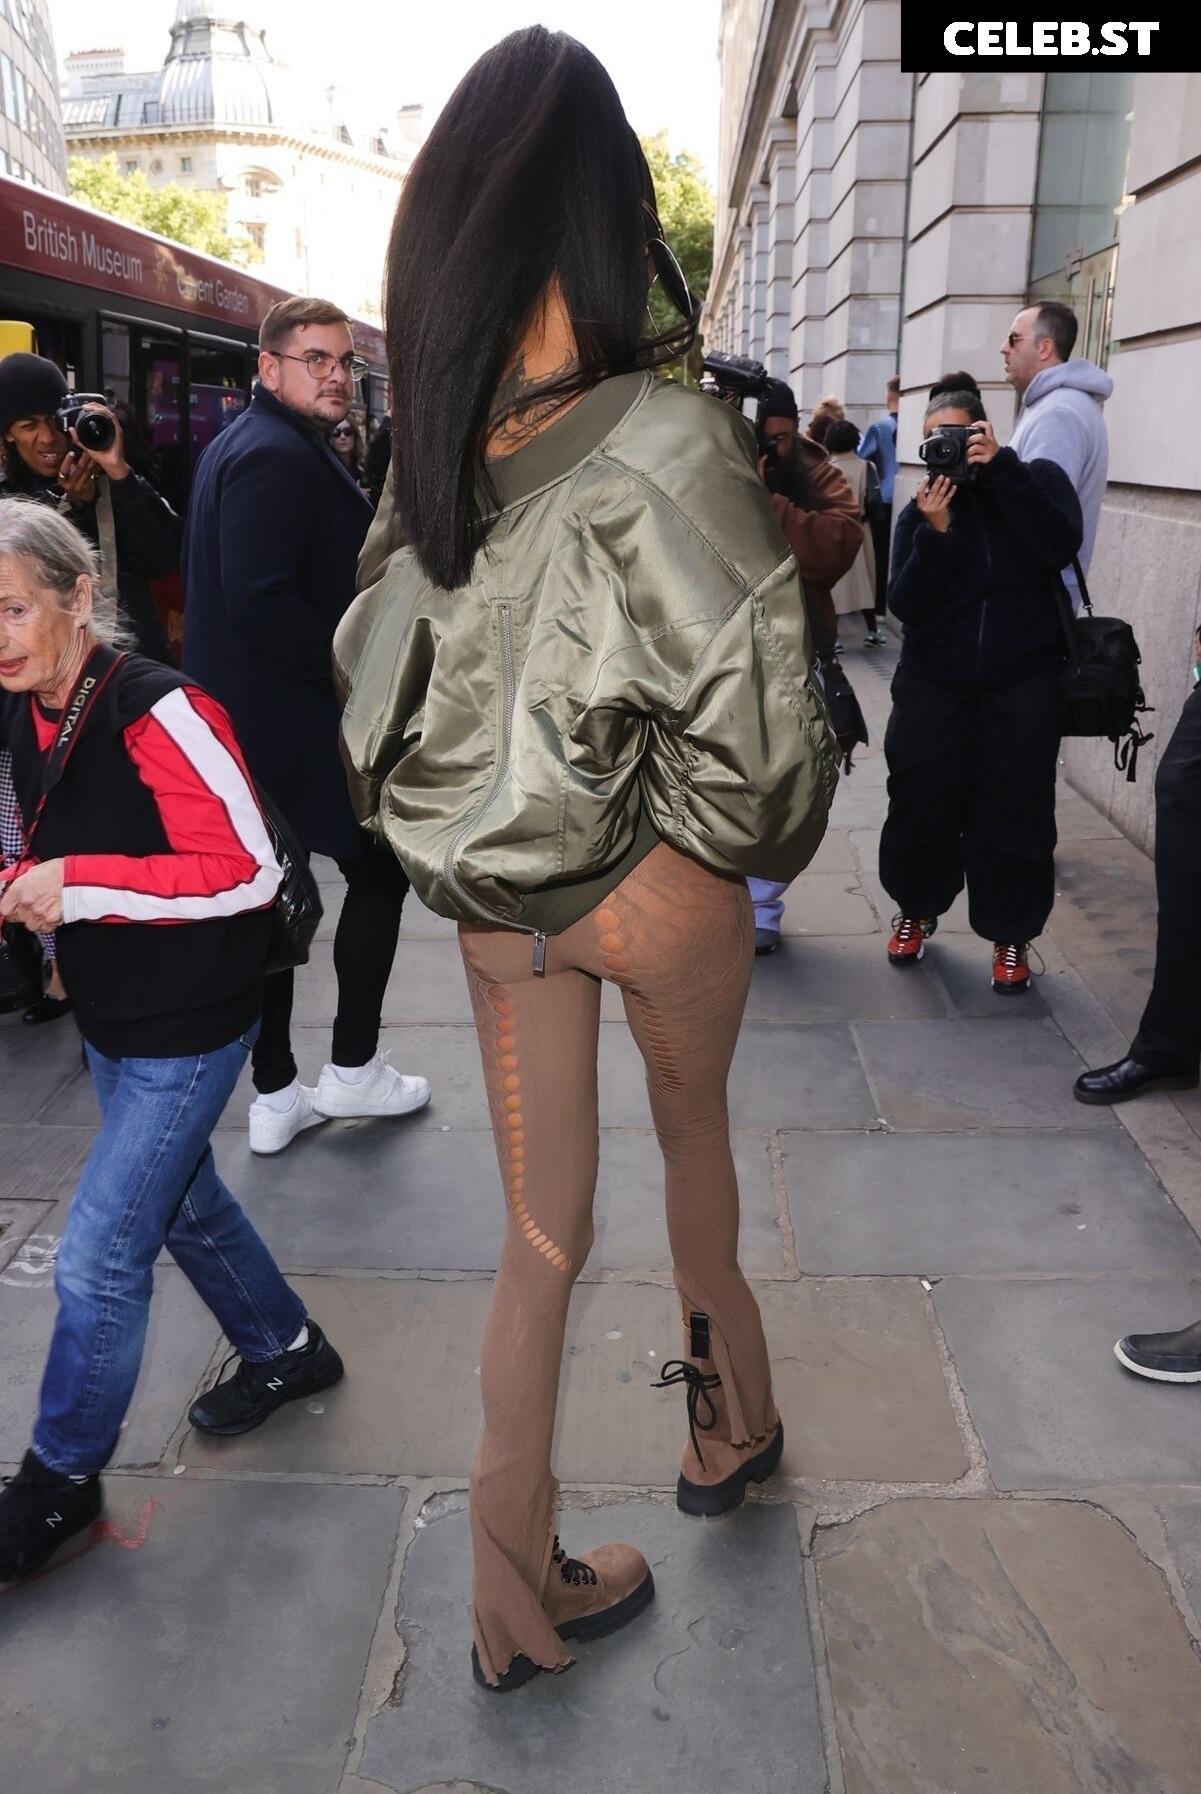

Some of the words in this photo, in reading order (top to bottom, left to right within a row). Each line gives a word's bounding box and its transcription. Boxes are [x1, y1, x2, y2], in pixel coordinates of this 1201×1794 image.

[23, 209, 78, 264] British
[81, 230, 143, 283] Museum
[57, 676, 97, 748] DIGITAL
